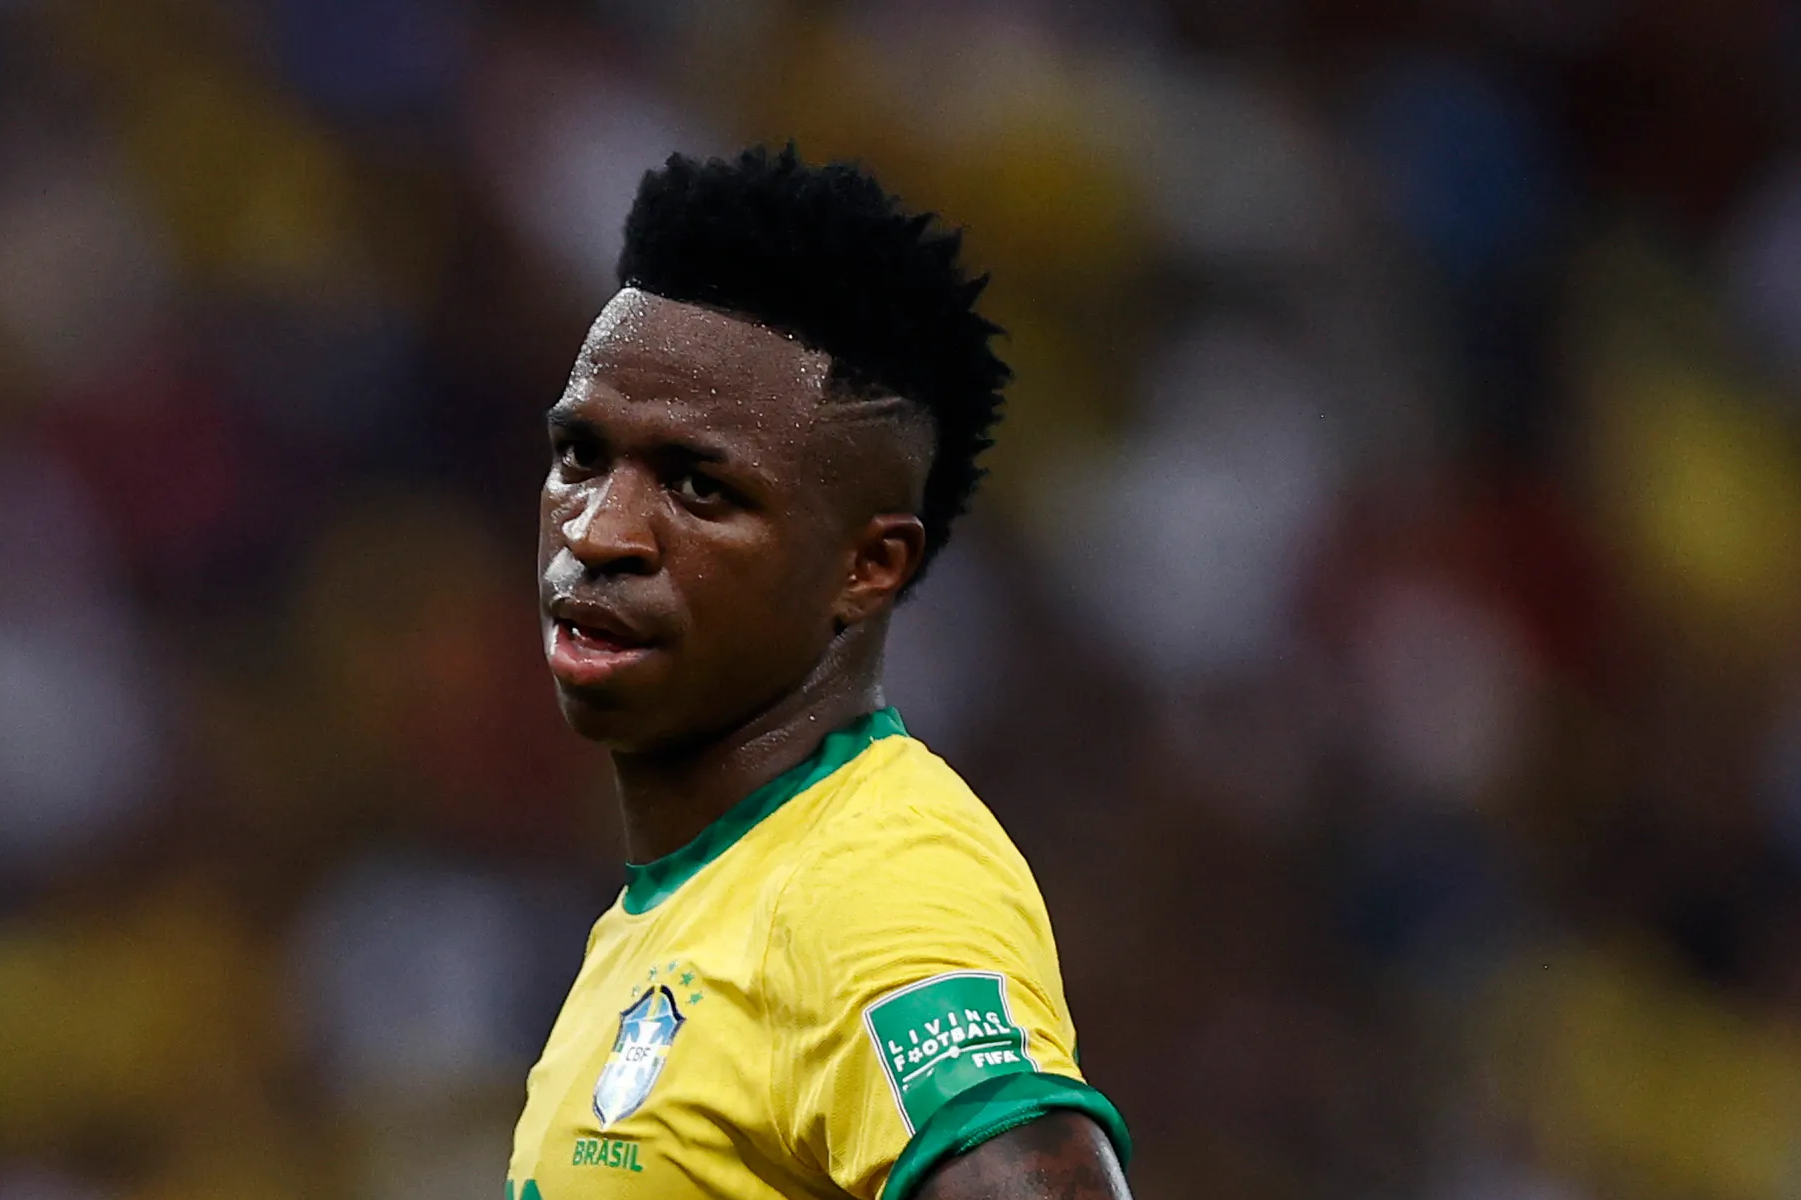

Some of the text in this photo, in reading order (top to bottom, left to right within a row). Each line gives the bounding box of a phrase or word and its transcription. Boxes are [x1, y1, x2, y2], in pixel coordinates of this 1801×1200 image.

[887, 1008, 1001, 1055] LIVING
[625, 1045, 651, 1062] CBF
[971, 1049, 1021, 1068] FIFA
[572, 1137, 644, 1173] BRASIL
